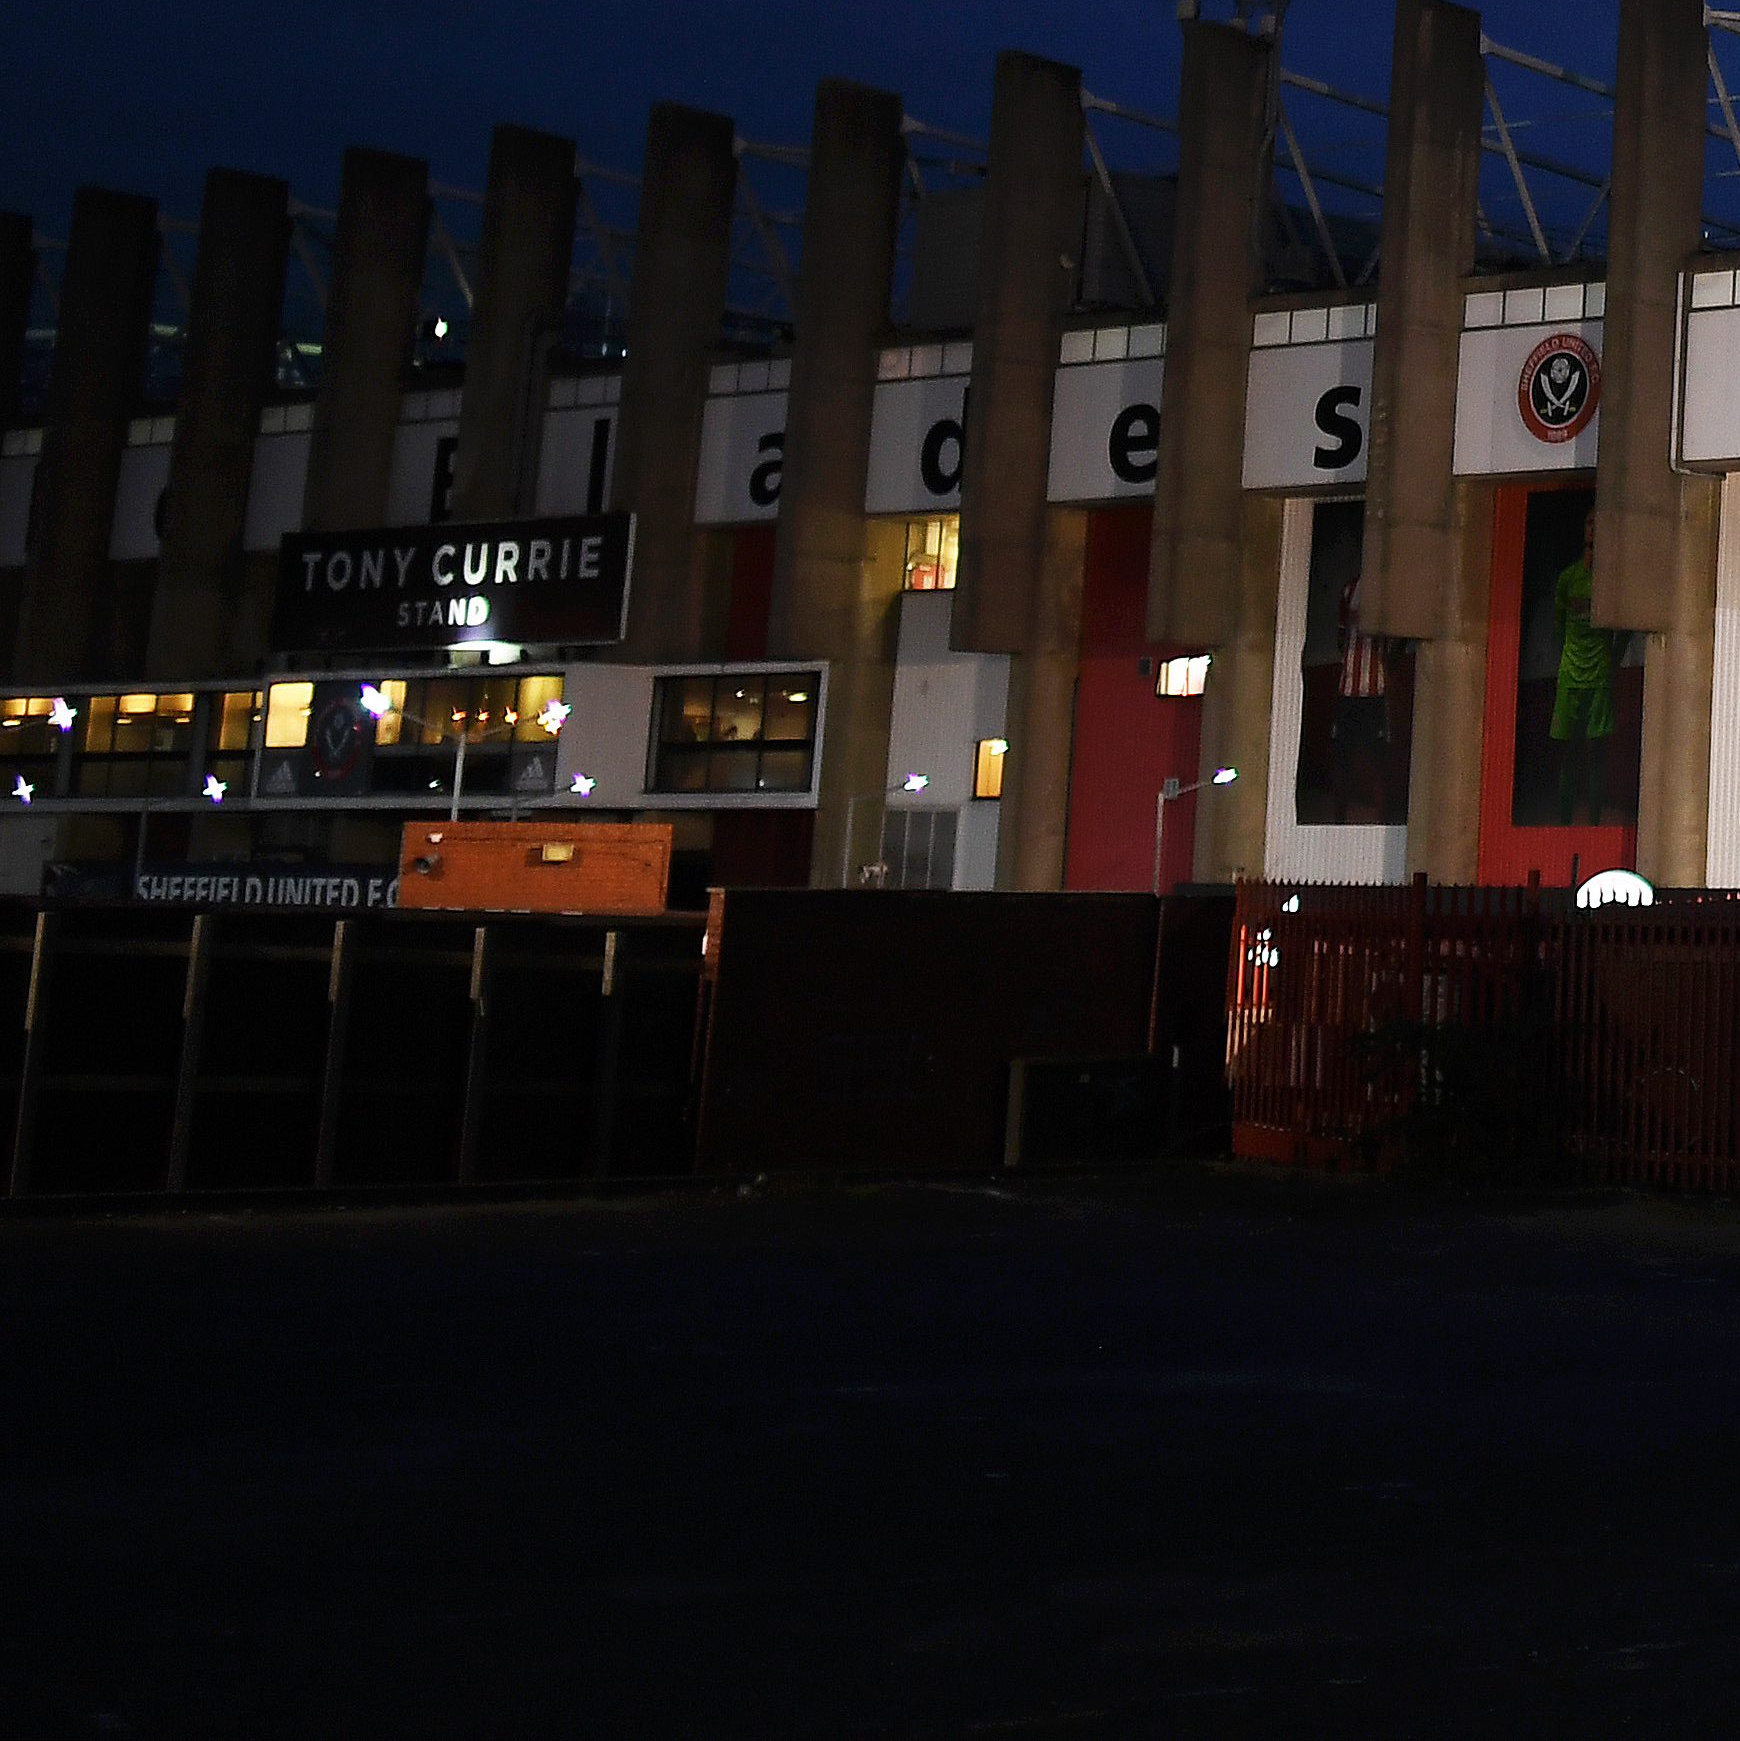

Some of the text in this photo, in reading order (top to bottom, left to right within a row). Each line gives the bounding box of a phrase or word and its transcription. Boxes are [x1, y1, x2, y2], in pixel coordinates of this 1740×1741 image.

[301, 535, 602, 592] TONY CURRIE
[397, 594, 491, 627] STAND
